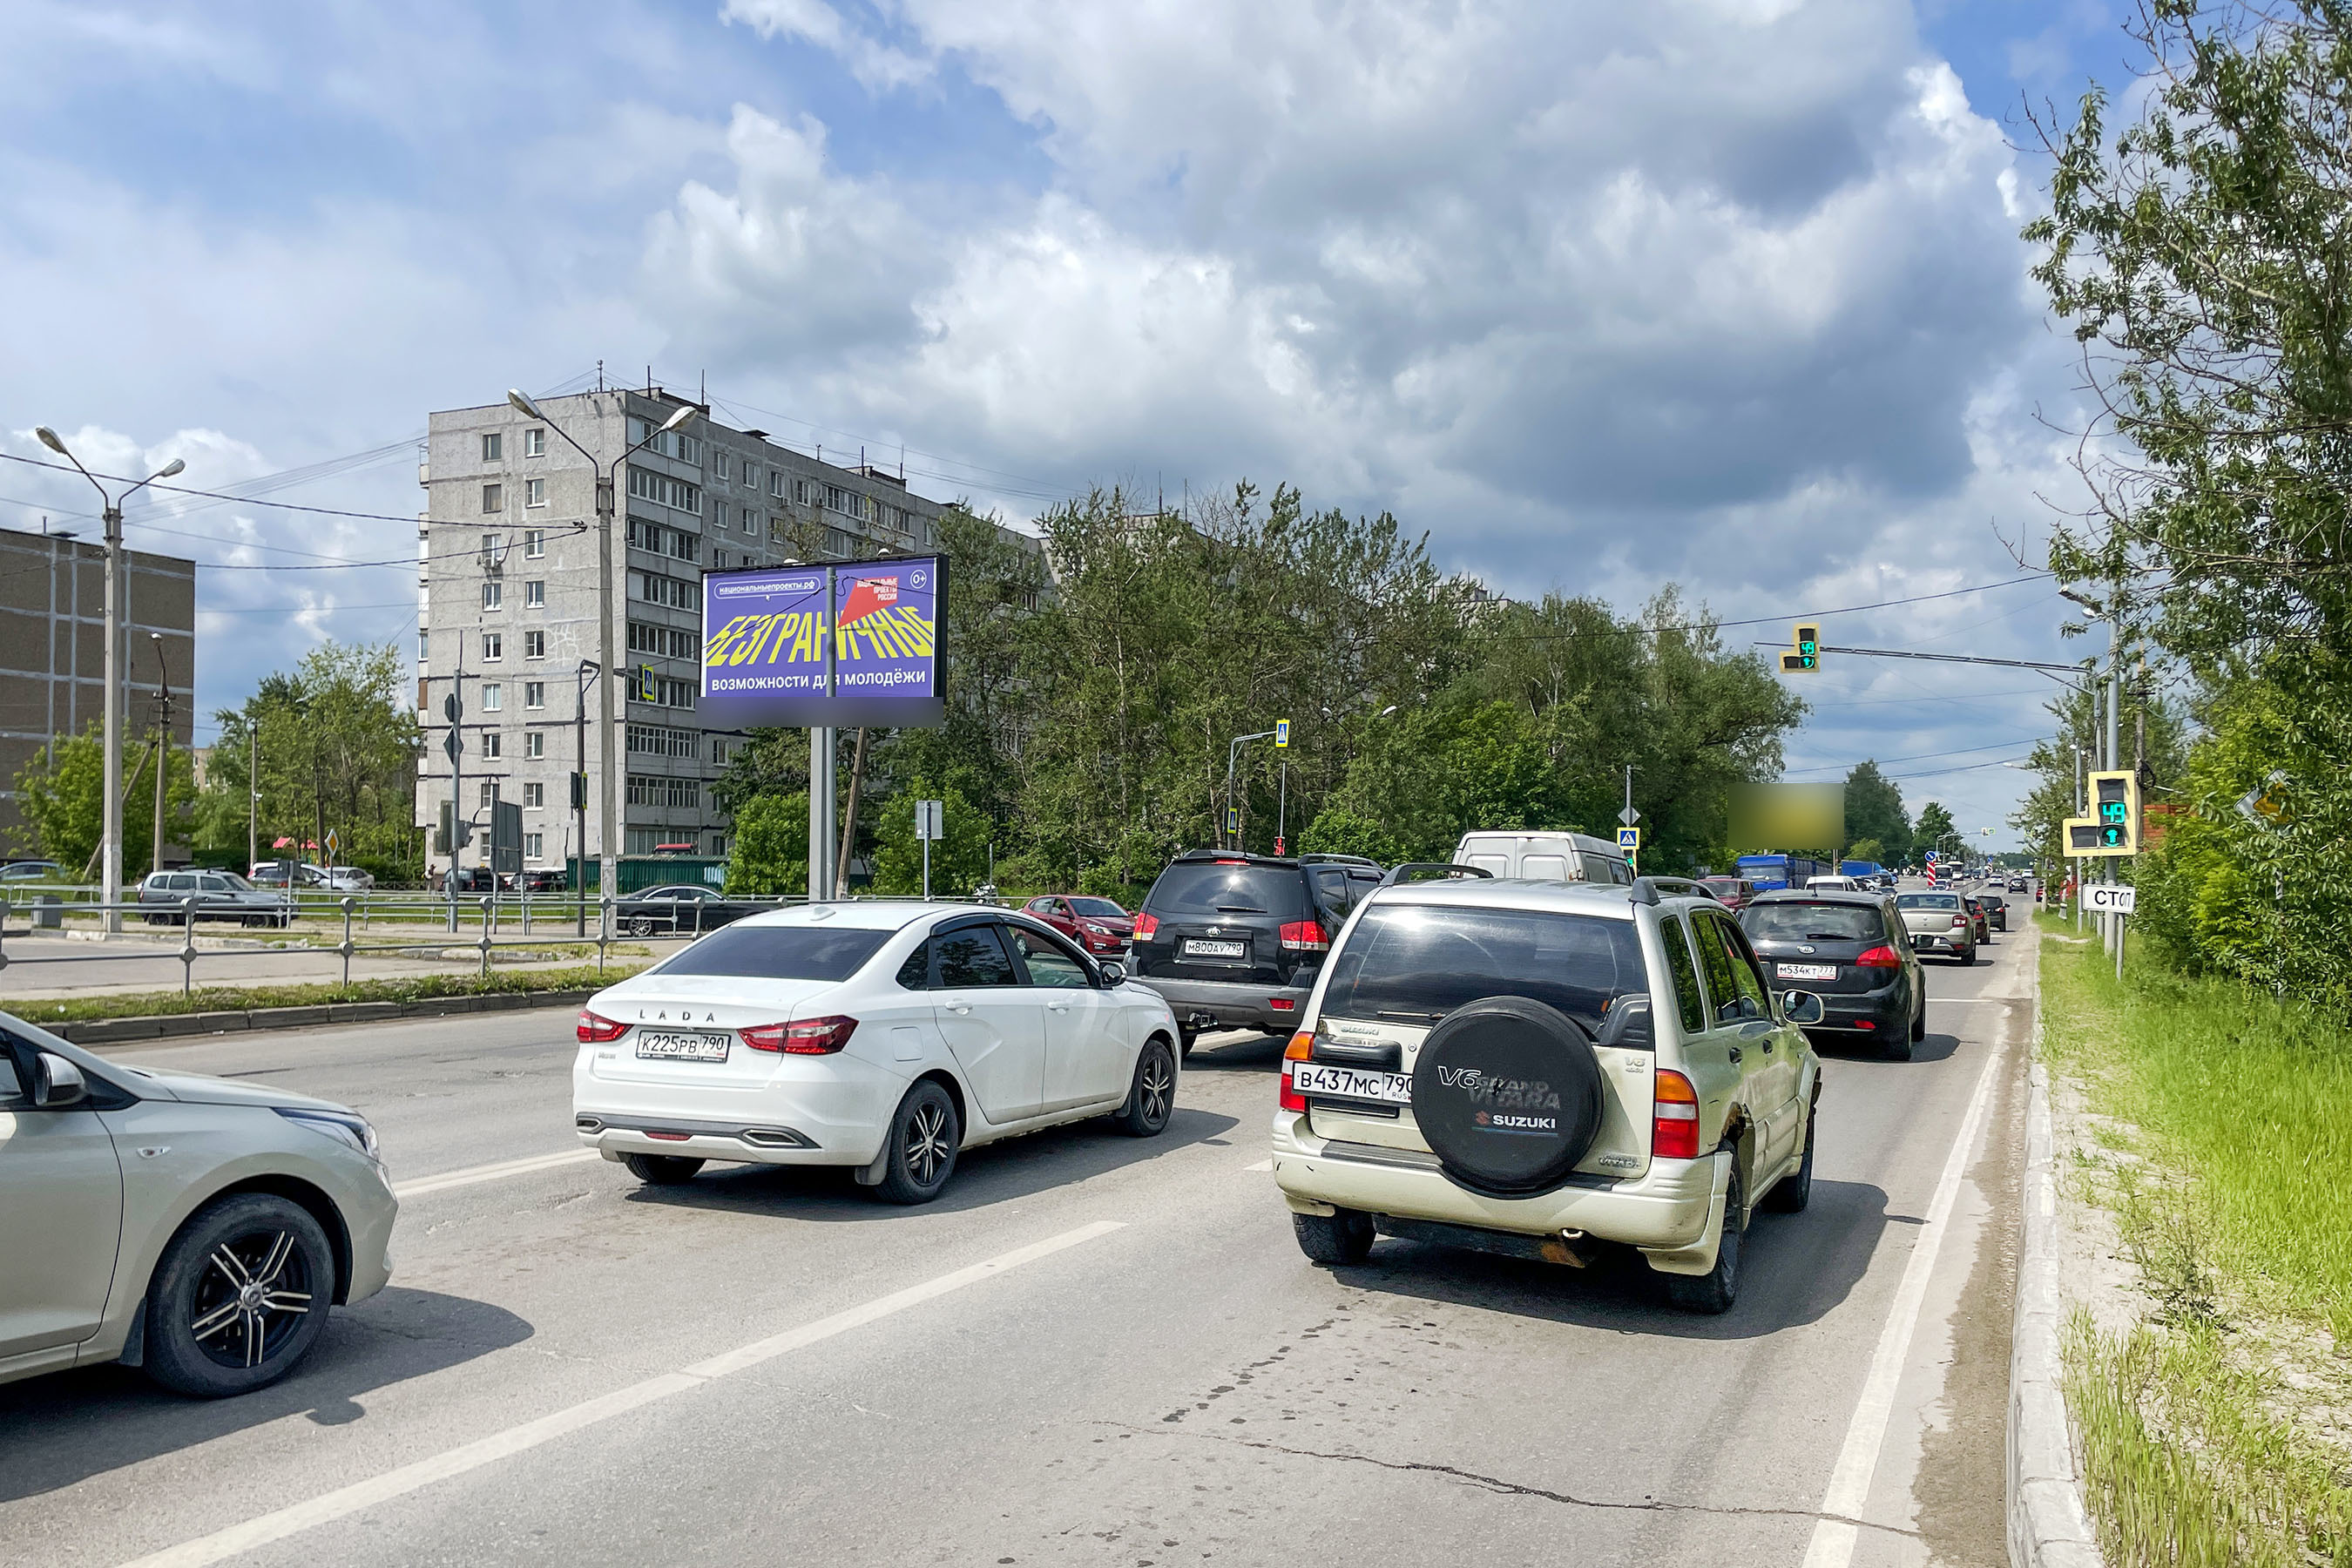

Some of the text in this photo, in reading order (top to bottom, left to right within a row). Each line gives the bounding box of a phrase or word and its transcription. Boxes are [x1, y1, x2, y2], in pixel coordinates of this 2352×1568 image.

[719, 579, 815, 594] национальныепроекты.рф
[912, 574, 926, 585] 0+
[1801, 641, 1815, 655] 49
[712, 675, 809, 691] возможности
[844, 668, 926, 686] молодёжи
[2102, 802, 2126, 823] 49
[639, 1009, 714, 1023] LADA
[1301, 1069, 1380, 1096] В437МС
[1437, 1065, 1482, 1089] V6
[1492, 1114, 1556, 1129] SUZUKI
